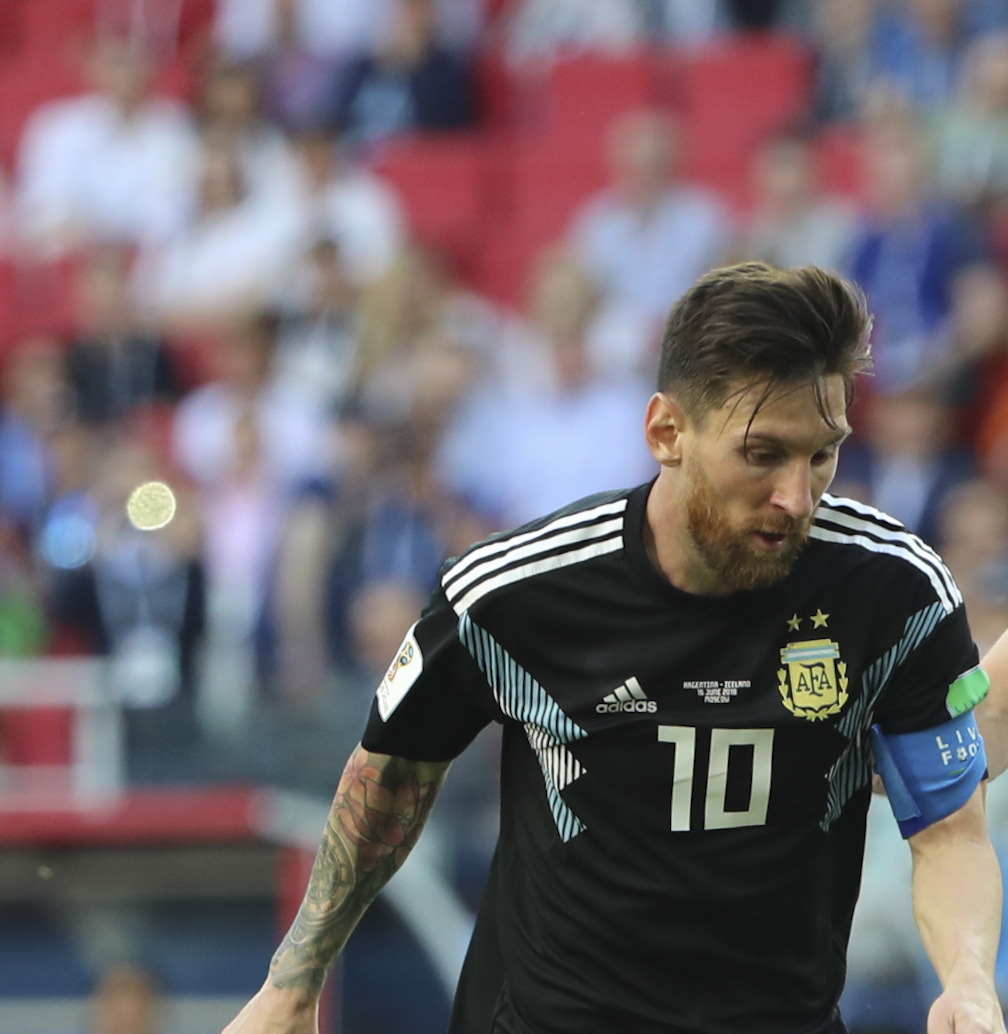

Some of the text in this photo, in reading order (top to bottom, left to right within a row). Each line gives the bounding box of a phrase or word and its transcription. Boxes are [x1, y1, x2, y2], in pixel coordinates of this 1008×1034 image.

[683, 681, 719, 689] ARGENTINA
[724, 680, 751, 688] ICELAND
[795, 662, 832, 697] AFA
[705, 688, 721, 696] JUNE
[722, 688, 738, 696] 2018
[704, 695, 730, 703] MOSCOW
[596, 699, 658, 713] adidas
[658, 725, 775, 832] 10
